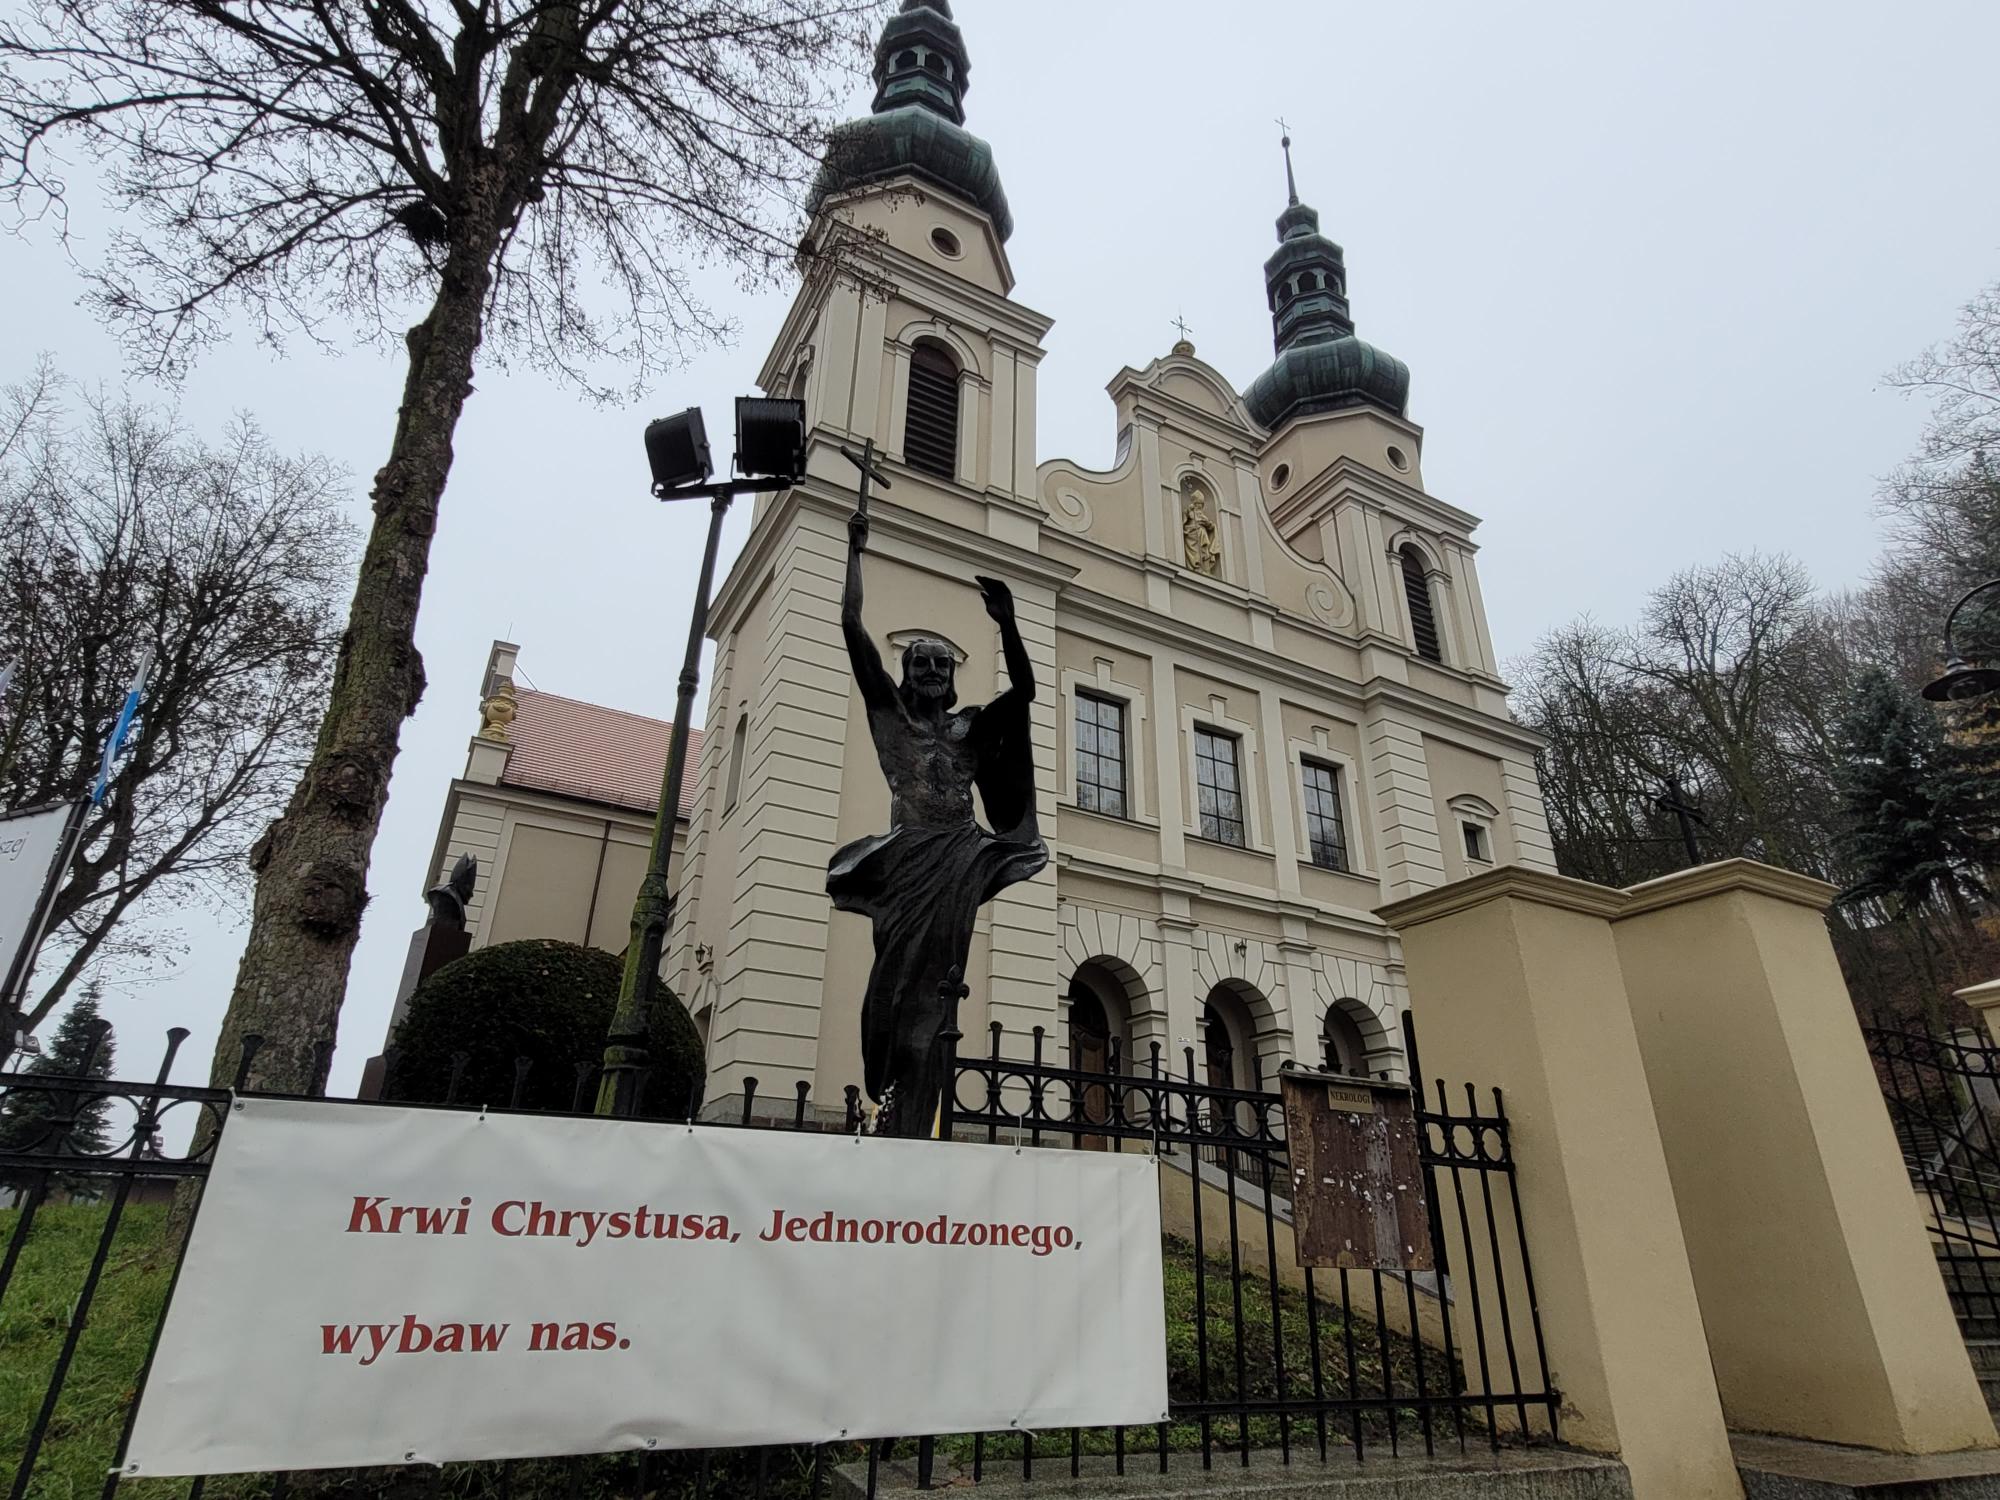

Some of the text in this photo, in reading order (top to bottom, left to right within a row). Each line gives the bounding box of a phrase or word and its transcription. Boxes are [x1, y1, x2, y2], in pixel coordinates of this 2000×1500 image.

[1330, 1091, 1371, 1104] NEKROLOGI
[345, 1196, 1083, 1256] Krwi Chrystusa, Jednorodzonego,
[320, 1314, 631, 1365] wybaw nas.
